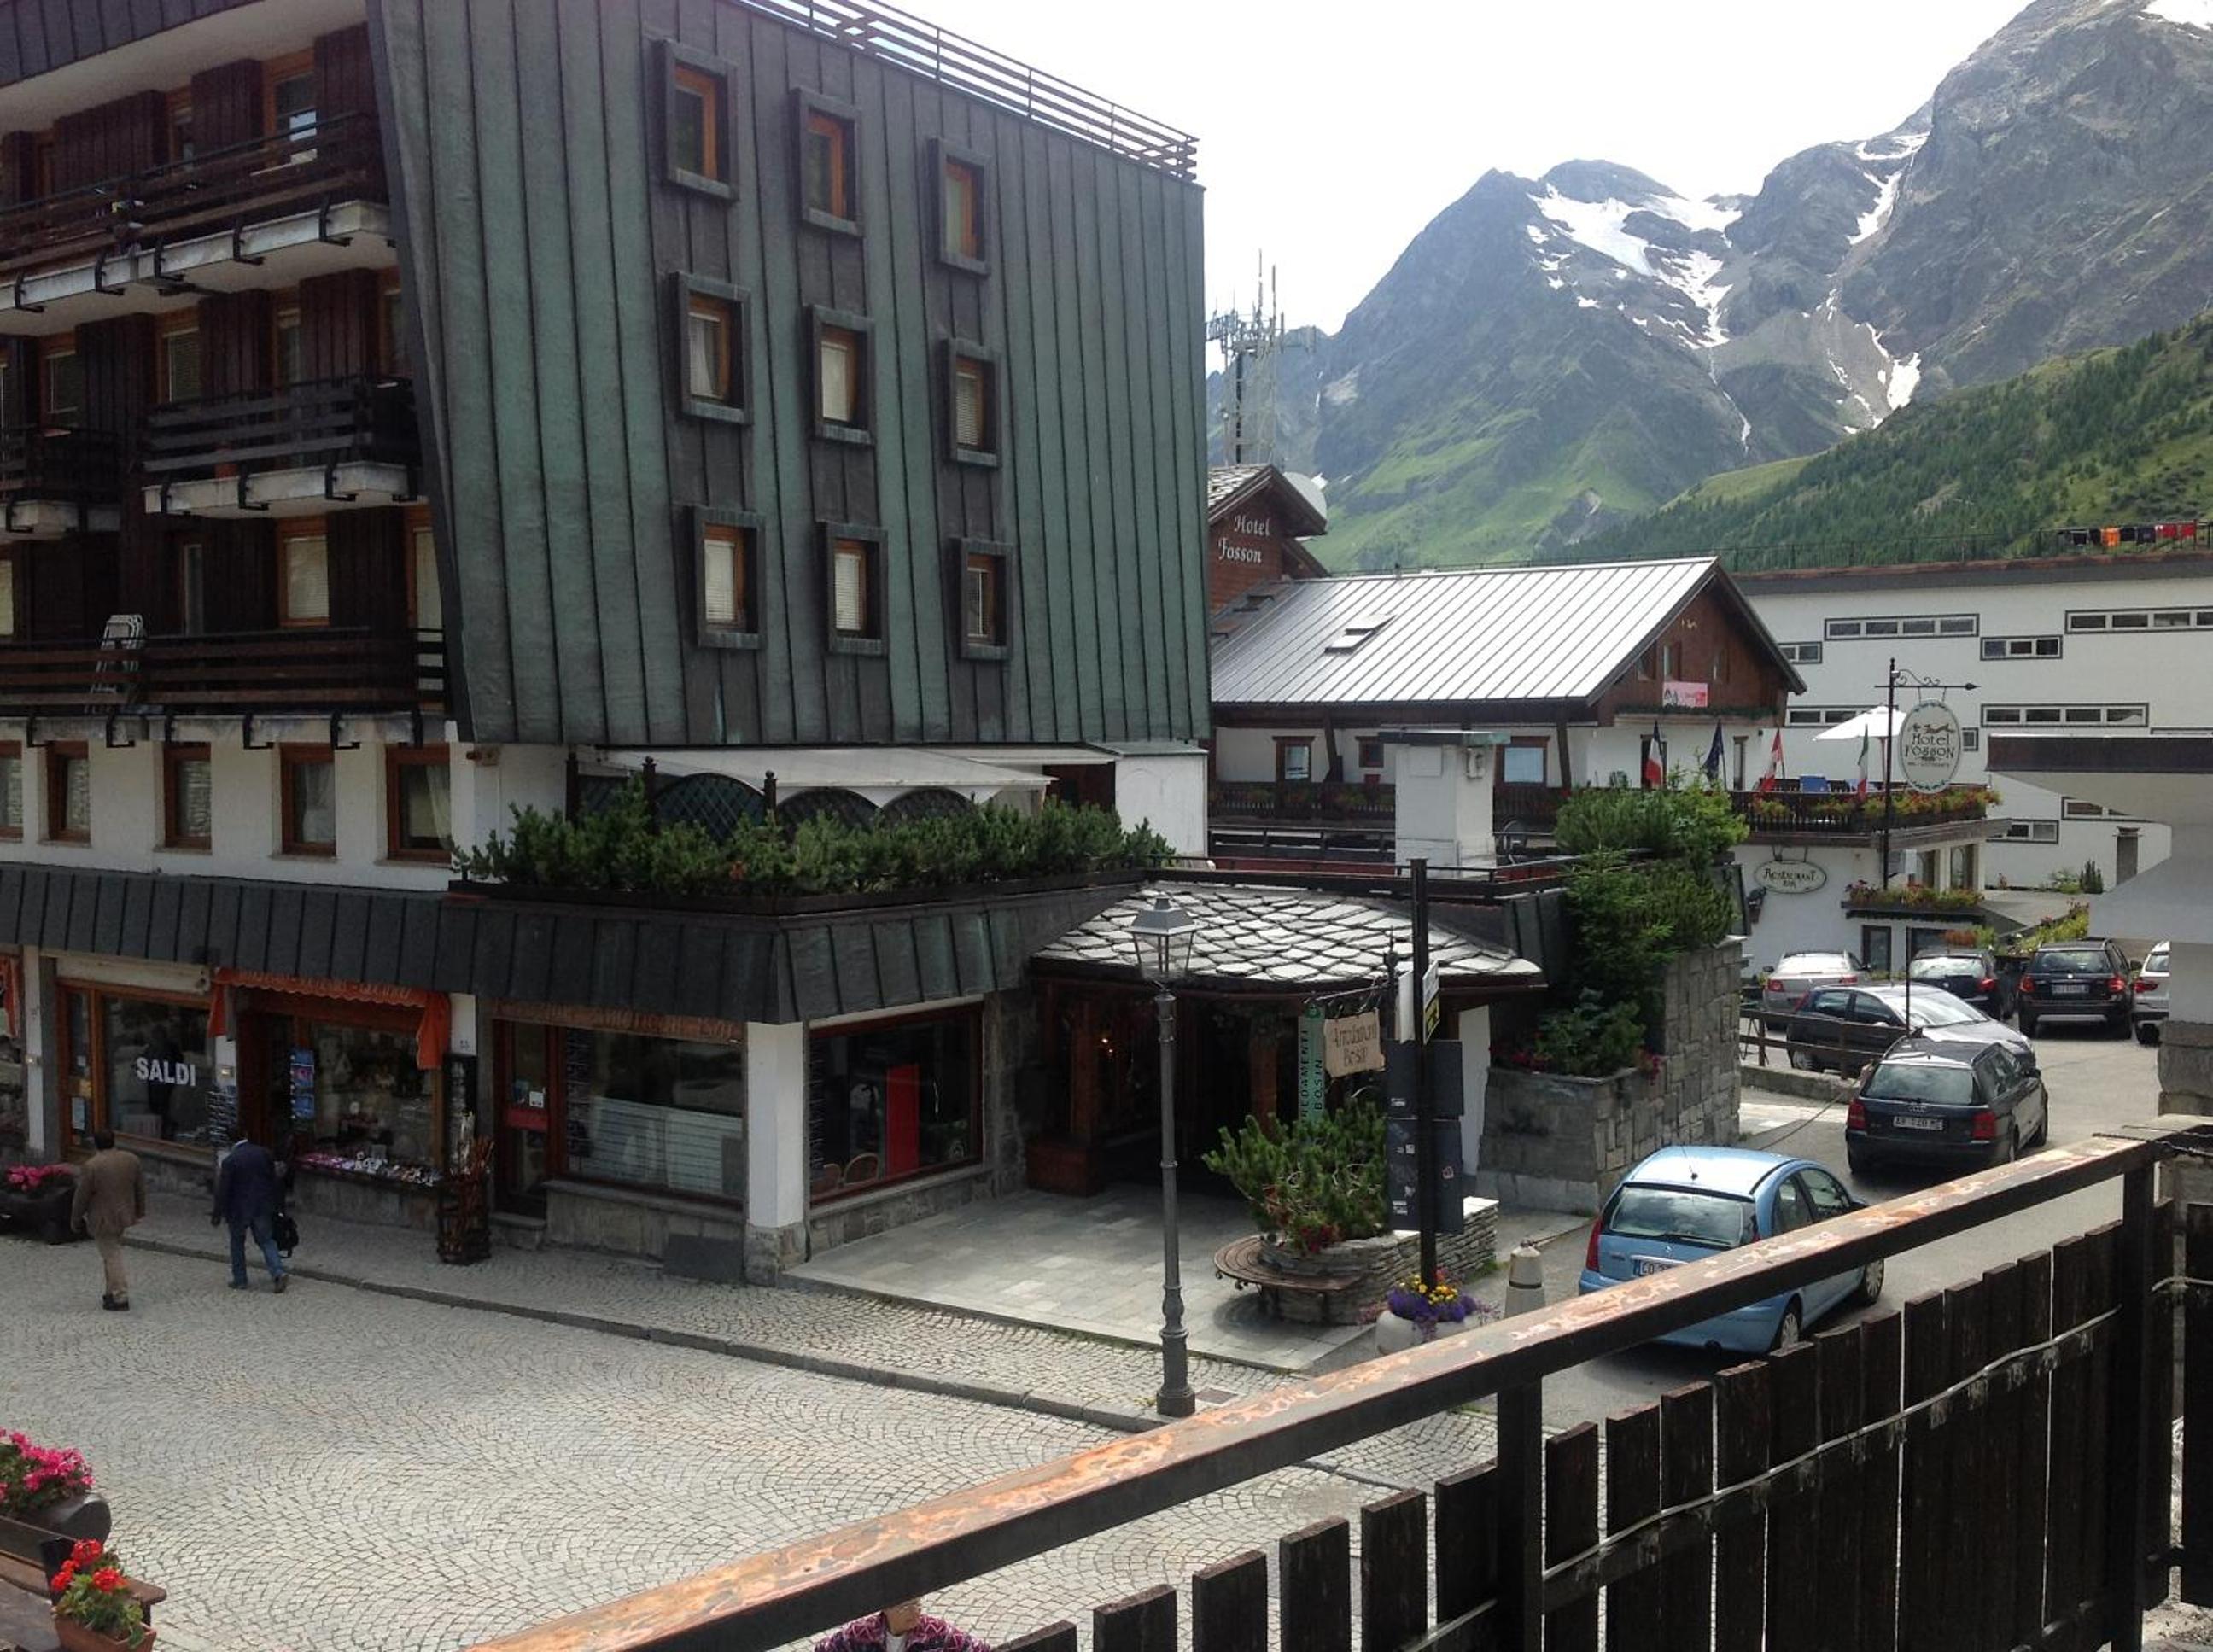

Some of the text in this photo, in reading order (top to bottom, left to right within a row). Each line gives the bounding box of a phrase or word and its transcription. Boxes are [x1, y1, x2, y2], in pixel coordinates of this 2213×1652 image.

[1234, 515, 1270, 536] Hotel
[1217, 537, 1263, 563] Fosson
[1912, 733, 1949, 745] Hotel
[136, 1057, 196, 1087] SALDI
[1314, 1059, 1323, 1110] BOSIN
